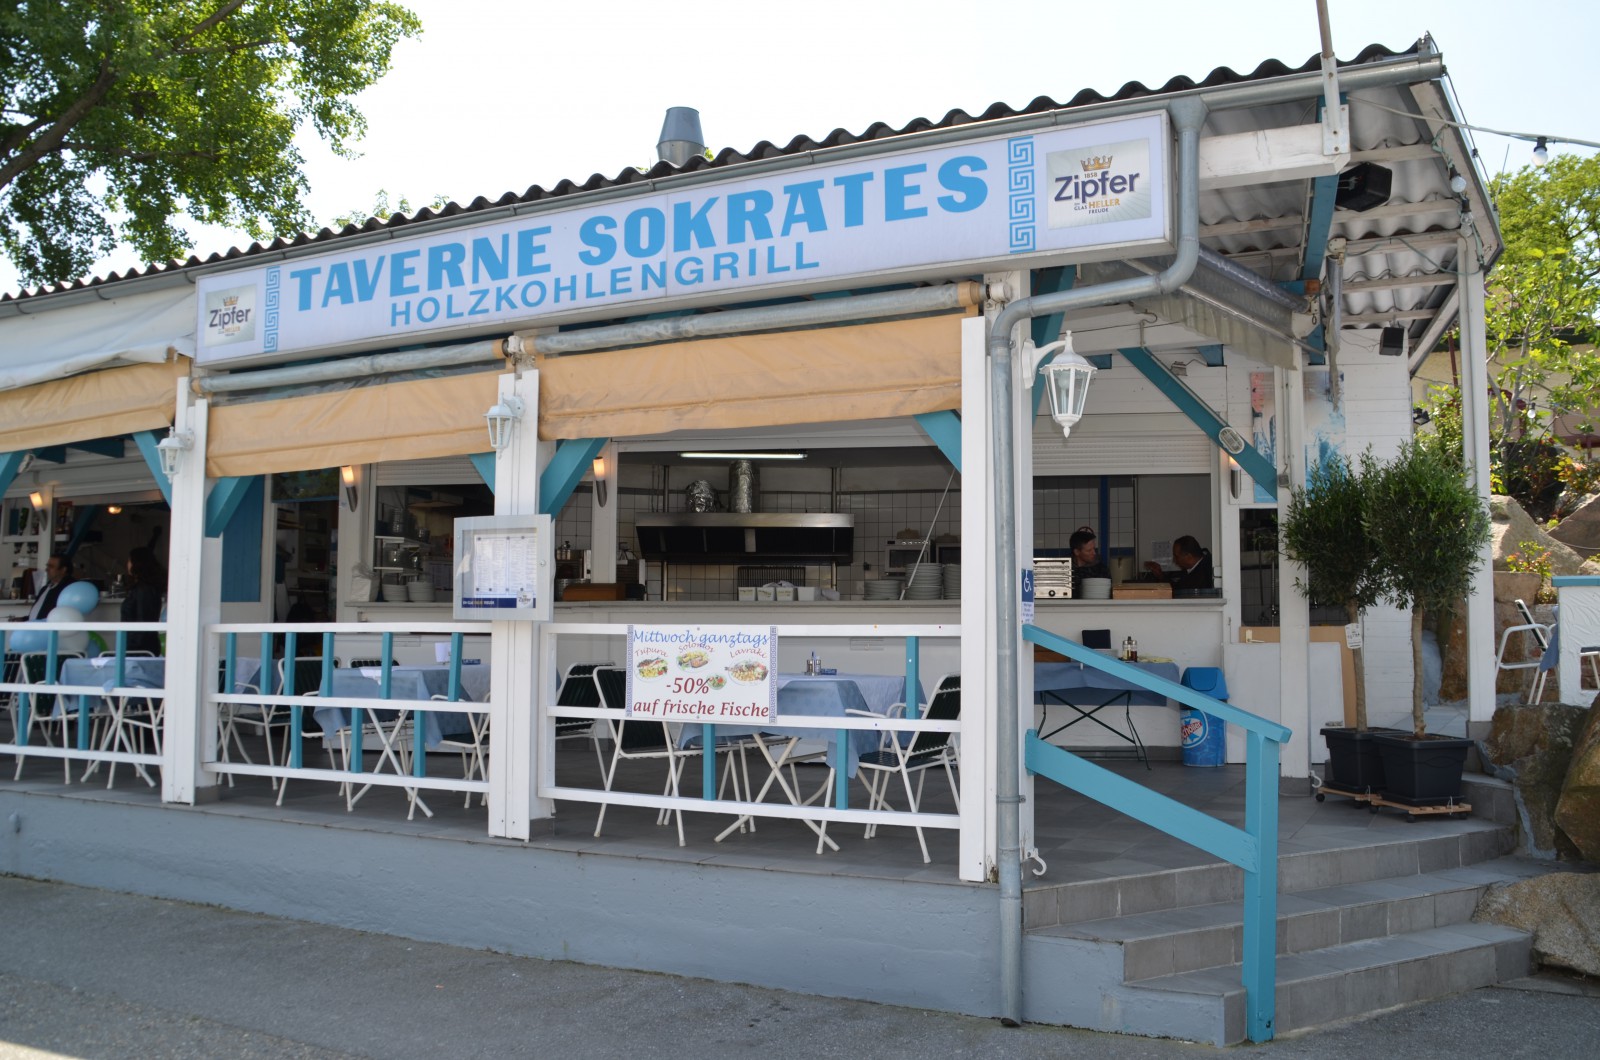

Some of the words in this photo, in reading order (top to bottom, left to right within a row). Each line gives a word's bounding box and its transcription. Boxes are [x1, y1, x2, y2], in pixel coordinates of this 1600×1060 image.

[1054, 170, 1140, 204] Zipfer
[1088, 198, 1121, 209] HELLER
[290, 226, 552, 312] TAVERNE
[578, 155, 988, 266] SOKRATES
[390, 241, 820, 327] HOLZKOHLENGRILL
[209, 306, 251, 330] Zipfer
[633, 629, 697, 643] Mittwoch
[699, 631, 771, 648] ganztags
[635, 646, 668, 658] Tsipura
[729, 646, 767, 659] Lavraki
[666, 677, 710, 694] -50%
[633, 699, 660, 715] auf
[662, 699, 715, 716] frische
[720, 701, 769, 717] Fische
